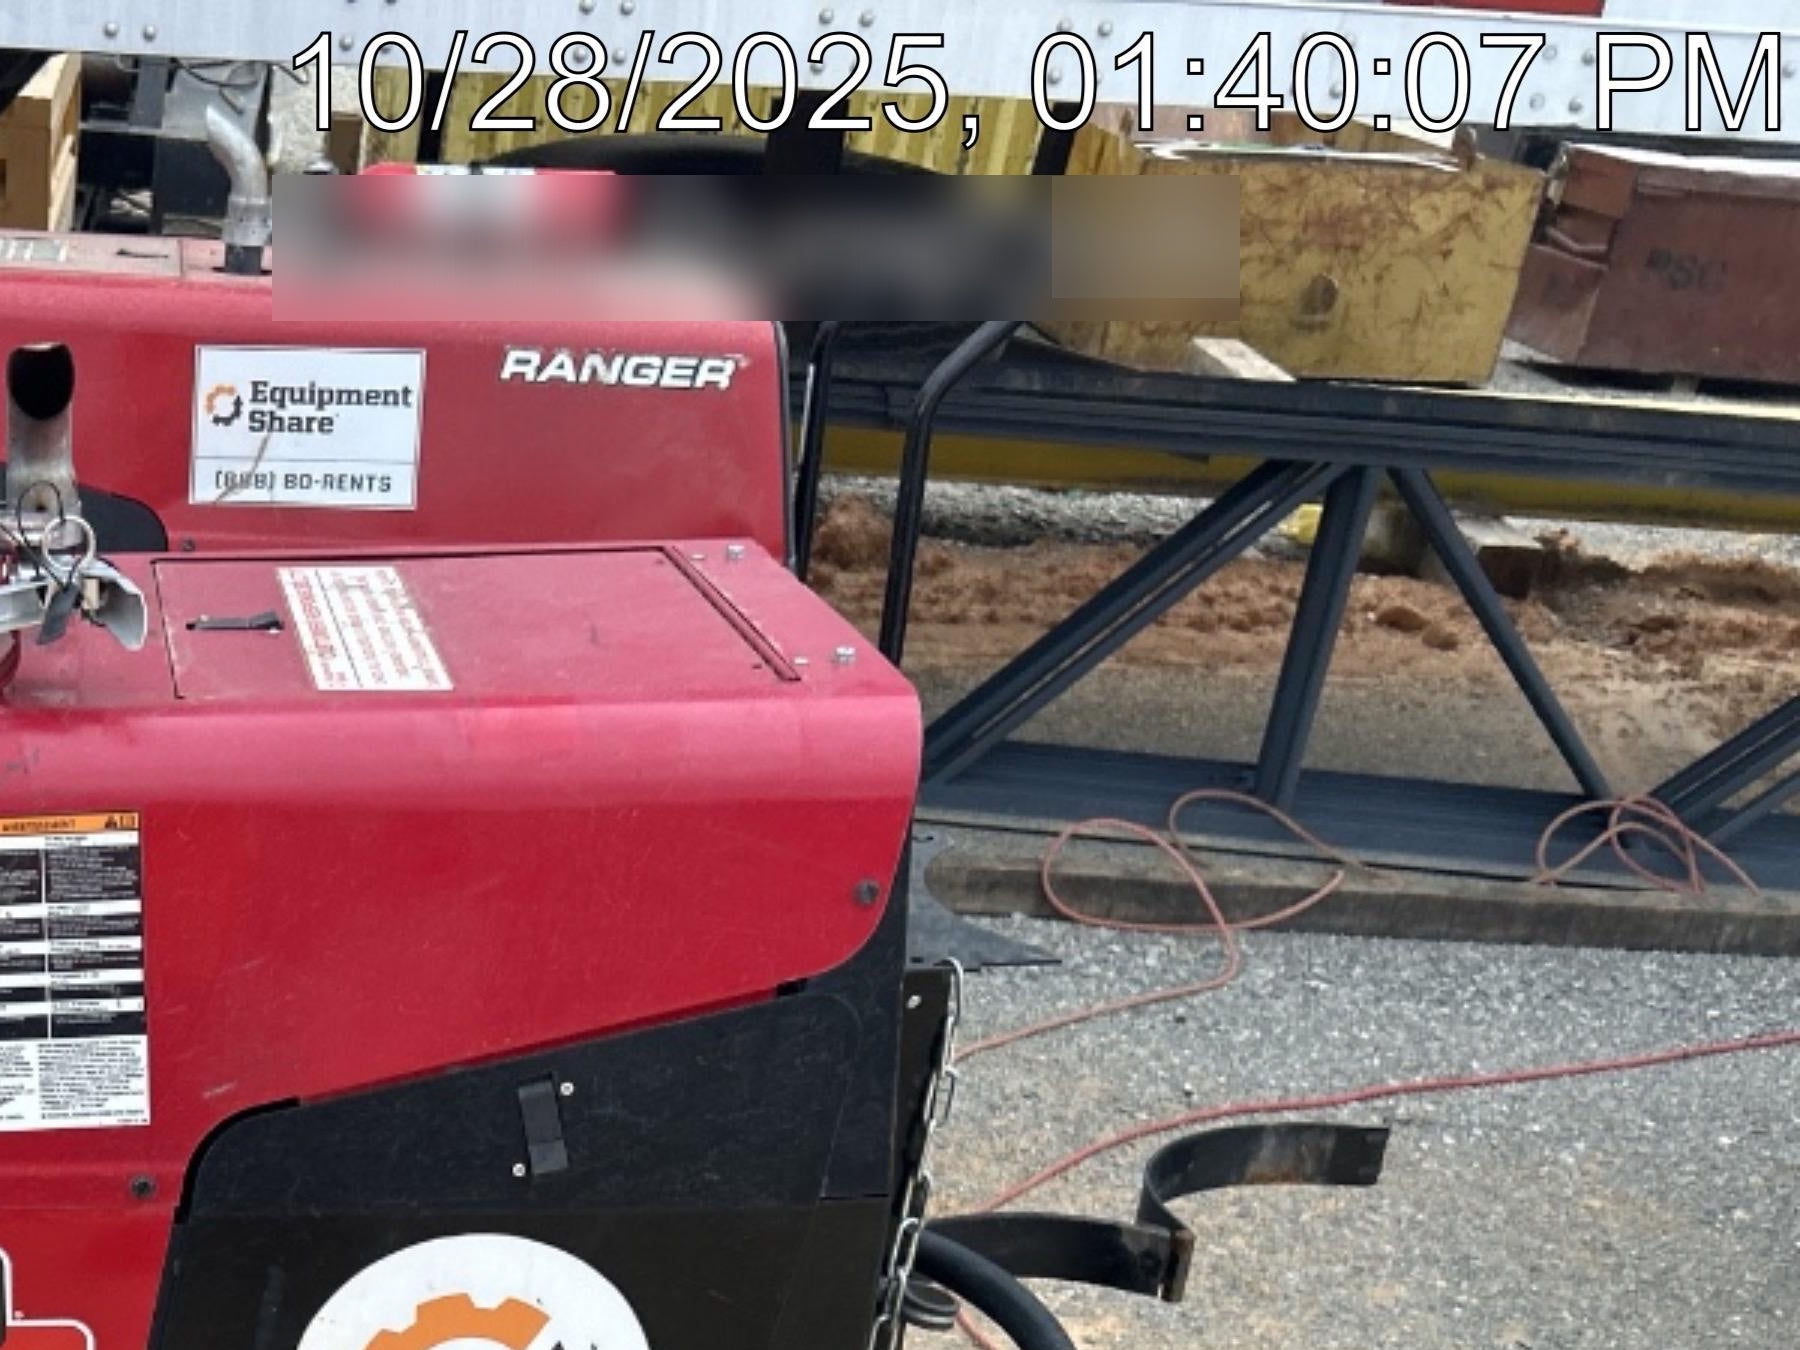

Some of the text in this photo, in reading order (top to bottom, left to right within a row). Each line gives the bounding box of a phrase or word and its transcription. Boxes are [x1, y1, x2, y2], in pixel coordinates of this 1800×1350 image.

[499, 349, 737, 391] RANGER
[250, 381, 413, 411] Equipment
[248, 410, 335, 434] Share
